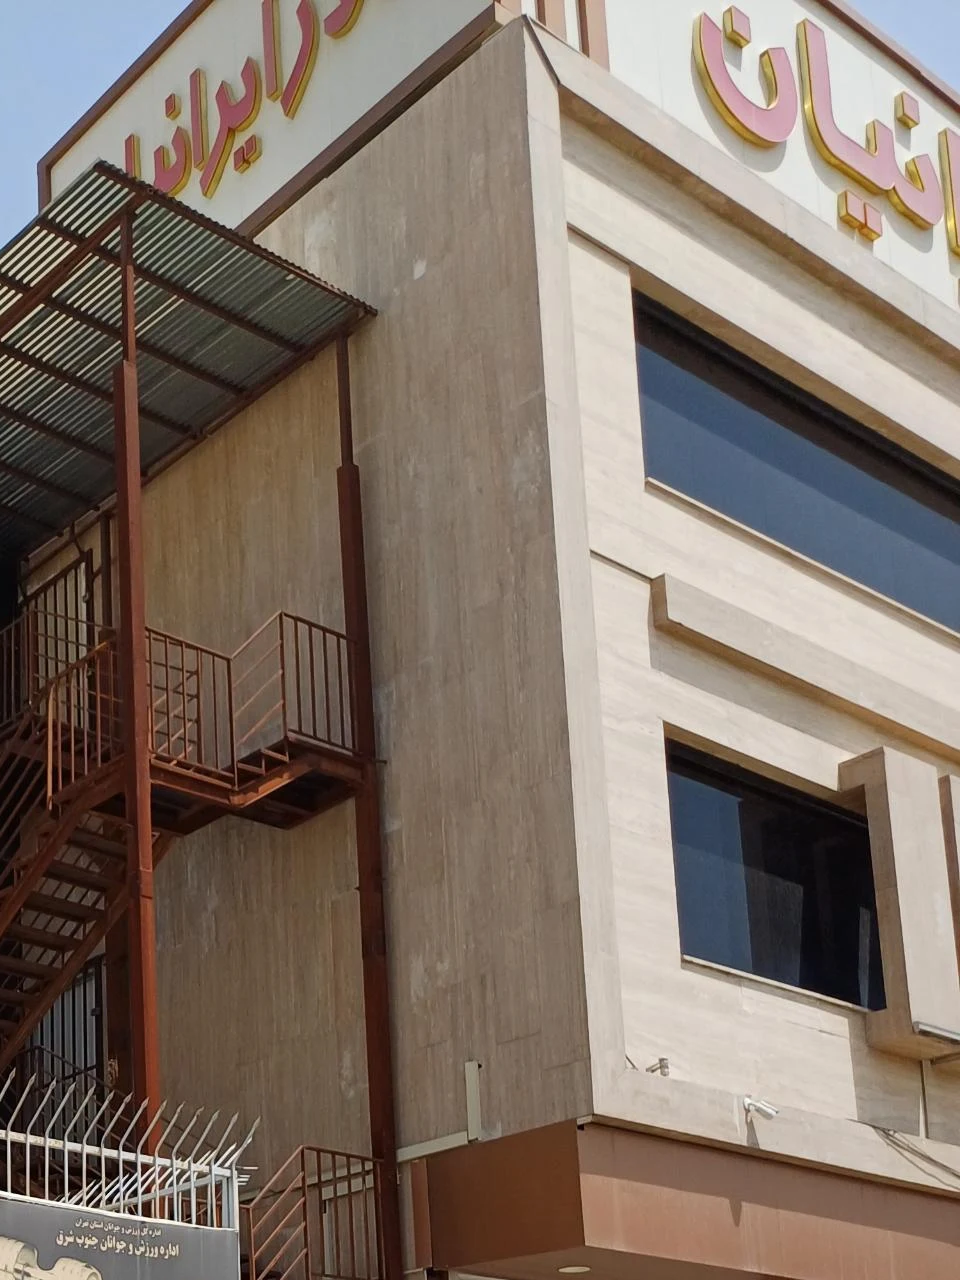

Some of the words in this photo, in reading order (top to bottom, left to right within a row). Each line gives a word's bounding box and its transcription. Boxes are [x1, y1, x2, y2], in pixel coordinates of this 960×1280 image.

[56, 1229, 75, 1246] شرق
[76, 1232, 98, 1250] جنوب
[100, 1234, 127, 1253] جوانان
[127, 1241, 134, 1255] و
[134, 1238, 158, 1258] ورزش
[159, 1241, 179, 1259] اداره
